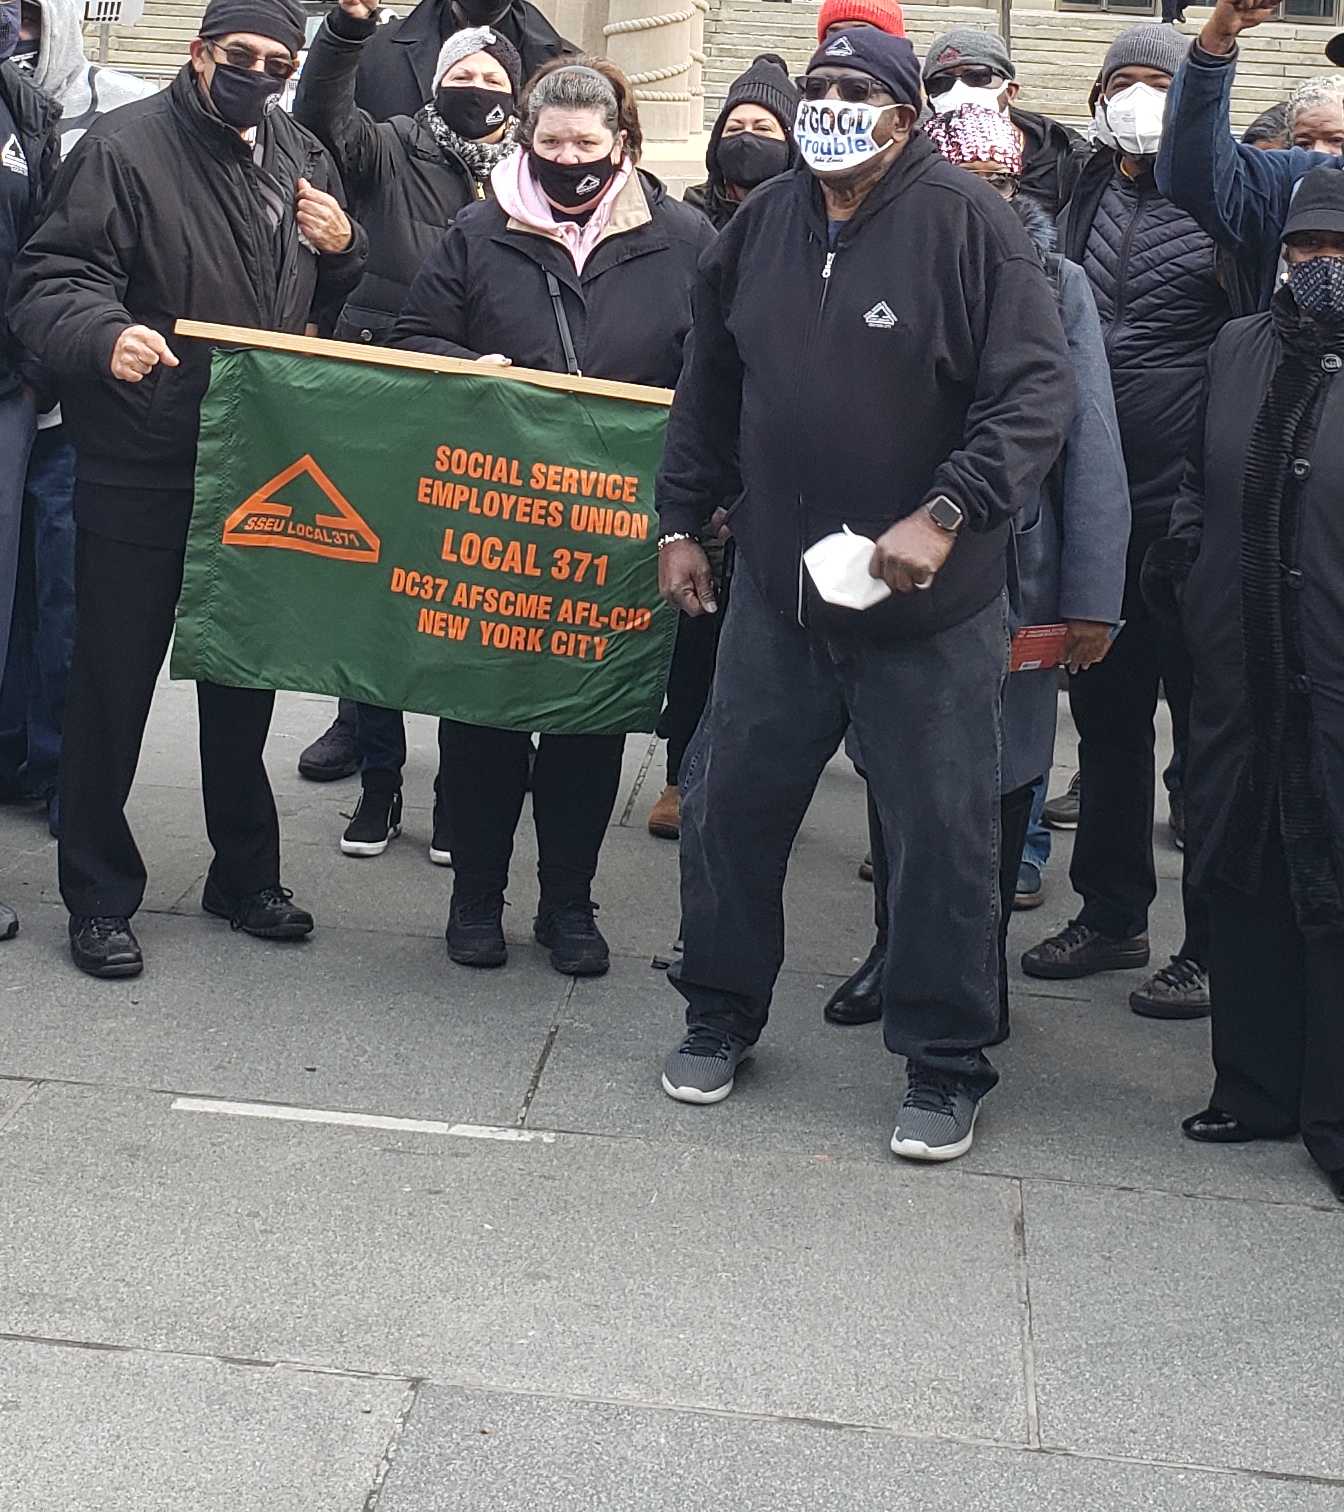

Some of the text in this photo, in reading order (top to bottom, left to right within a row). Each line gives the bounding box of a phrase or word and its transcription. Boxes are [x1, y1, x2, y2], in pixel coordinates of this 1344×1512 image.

[83, 1, 122, 22] L!!!!
[435, 445, 638, 503] SOCIAL SERVICE
[244, 517, 286, 532] SSEU
[417, 477, 649, 540] EMPLOYEES UNION
[441, 528, 609, 586] LOCAL 371
[390, 567, 652, 631] DC37 AFSCME AFL-CIO
[418, 608, 609, 661] NEW YORK CITY
